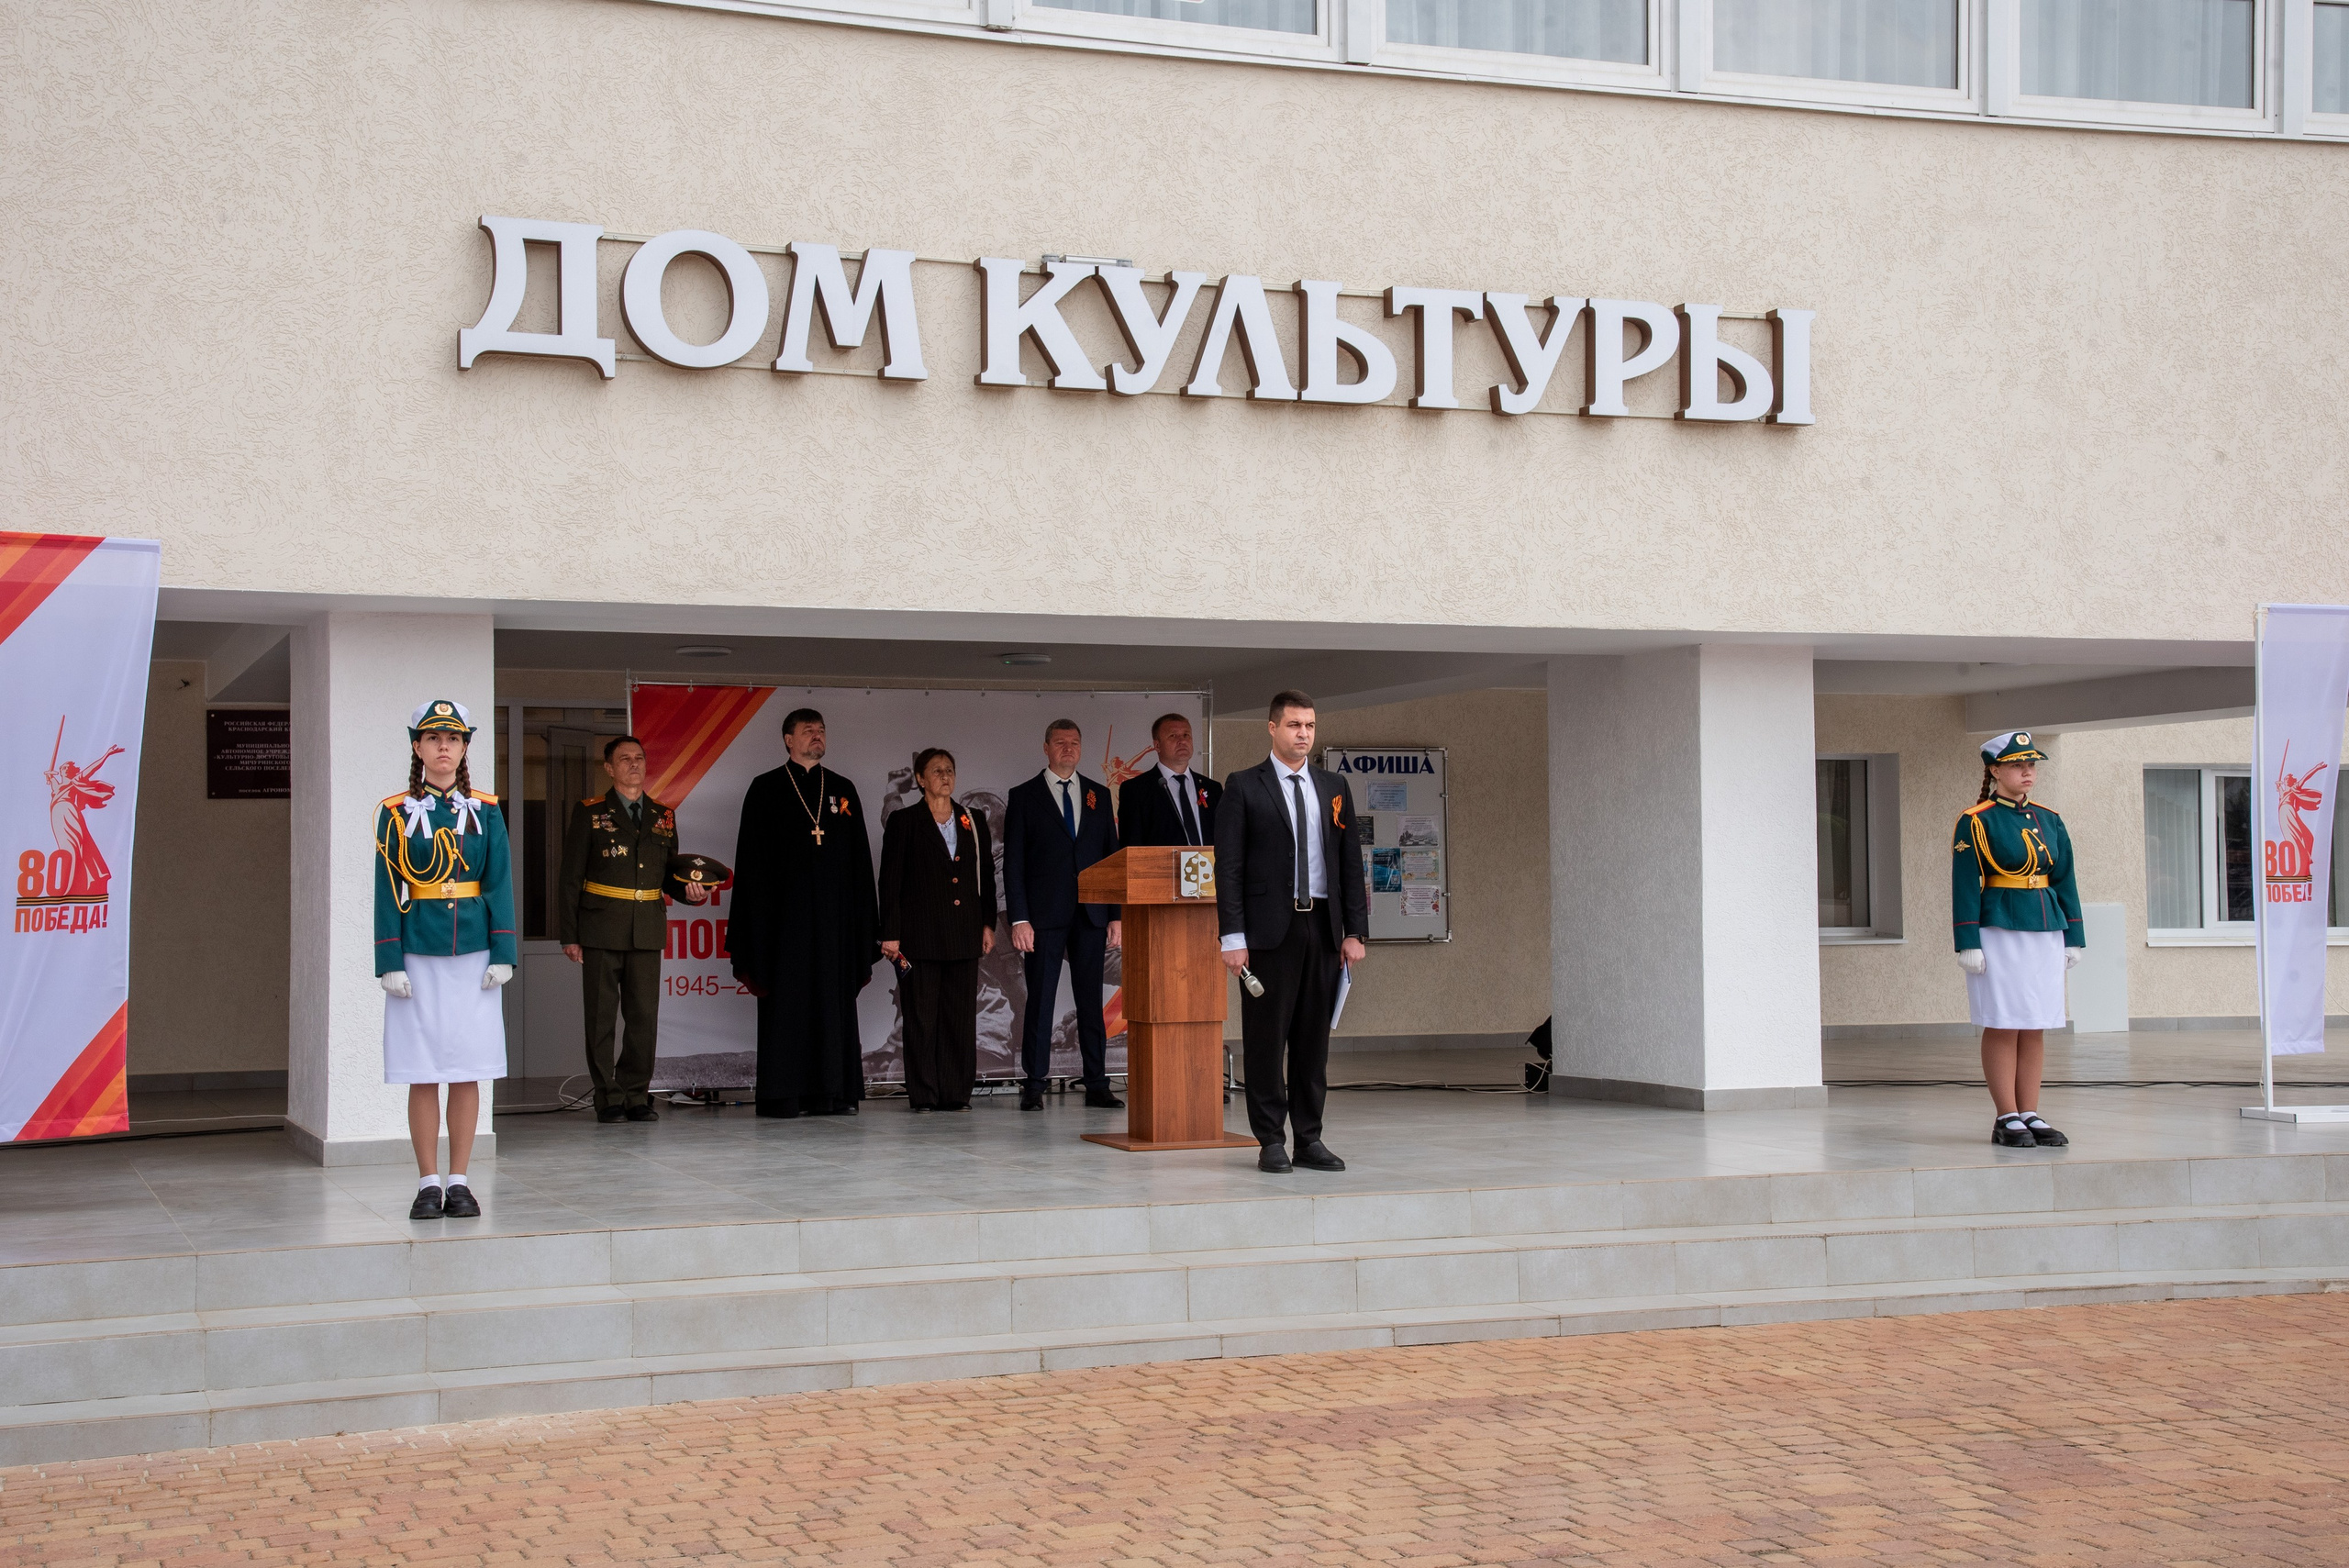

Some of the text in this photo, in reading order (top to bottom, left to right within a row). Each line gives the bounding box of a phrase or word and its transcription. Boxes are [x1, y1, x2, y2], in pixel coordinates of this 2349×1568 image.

[457, 215, 1816, 425] ДОМ КУЛЬТУРЫ
[1337, 755, 1435, 773] АФИША
[17, 849, 72, 897] 80
[15, 904, 108, 934] ПОБЕДА!
